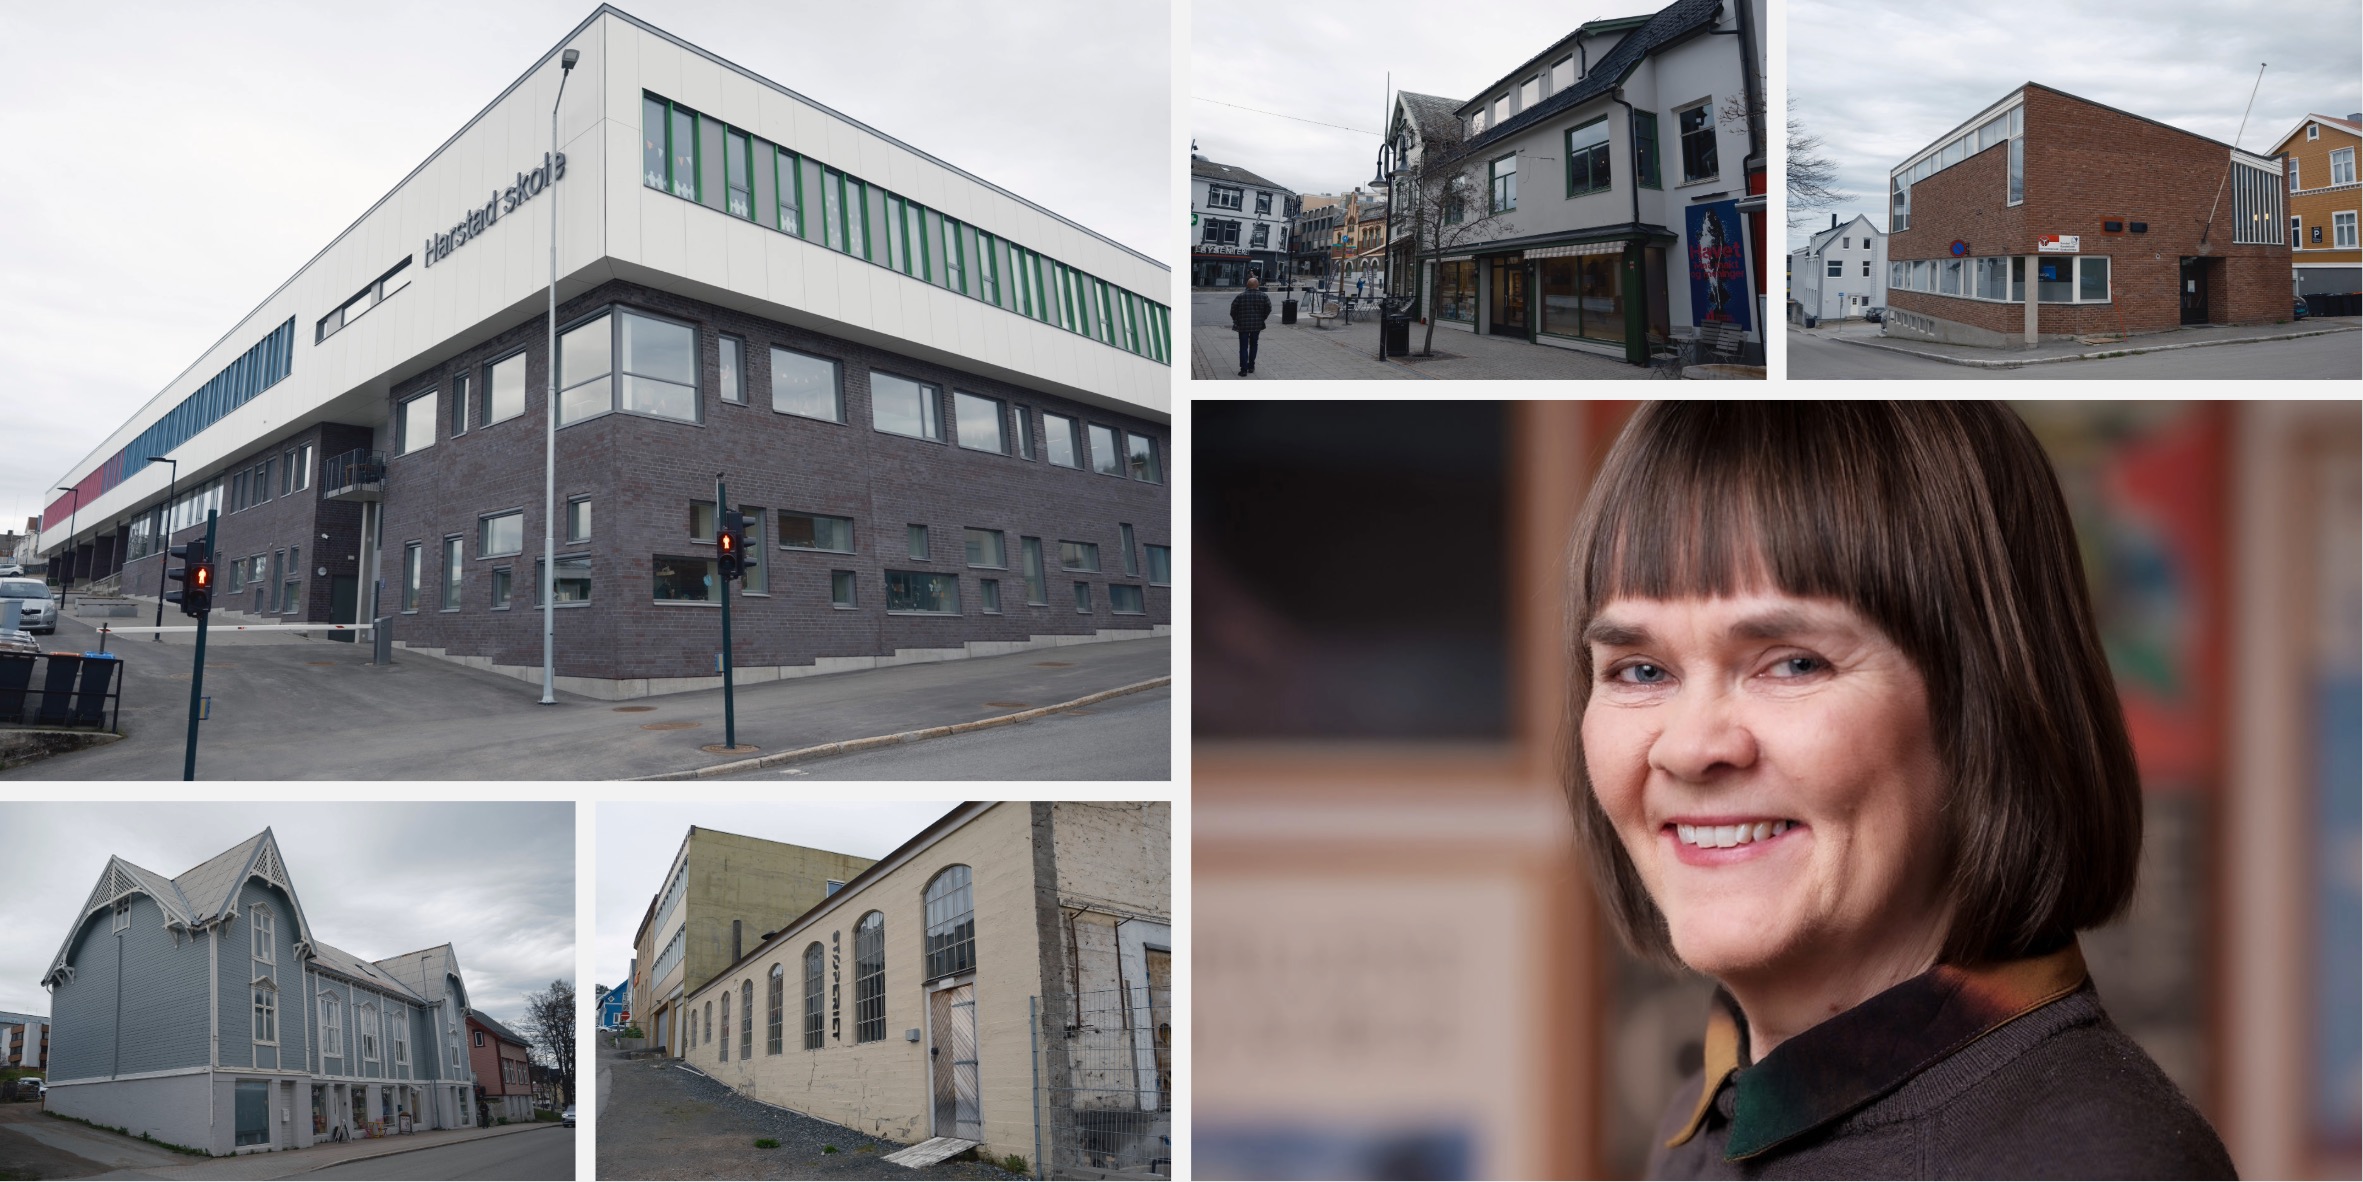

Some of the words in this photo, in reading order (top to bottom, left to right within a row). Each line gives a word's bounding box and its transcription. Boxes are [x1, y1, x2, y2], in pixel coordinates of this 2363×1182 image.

[424, 189, 498, 269] Harstad
[503, 151, 567, 214] skole
[1690, 241, 1742, 259] Havet
[1691, 271, 1702, 280] og
